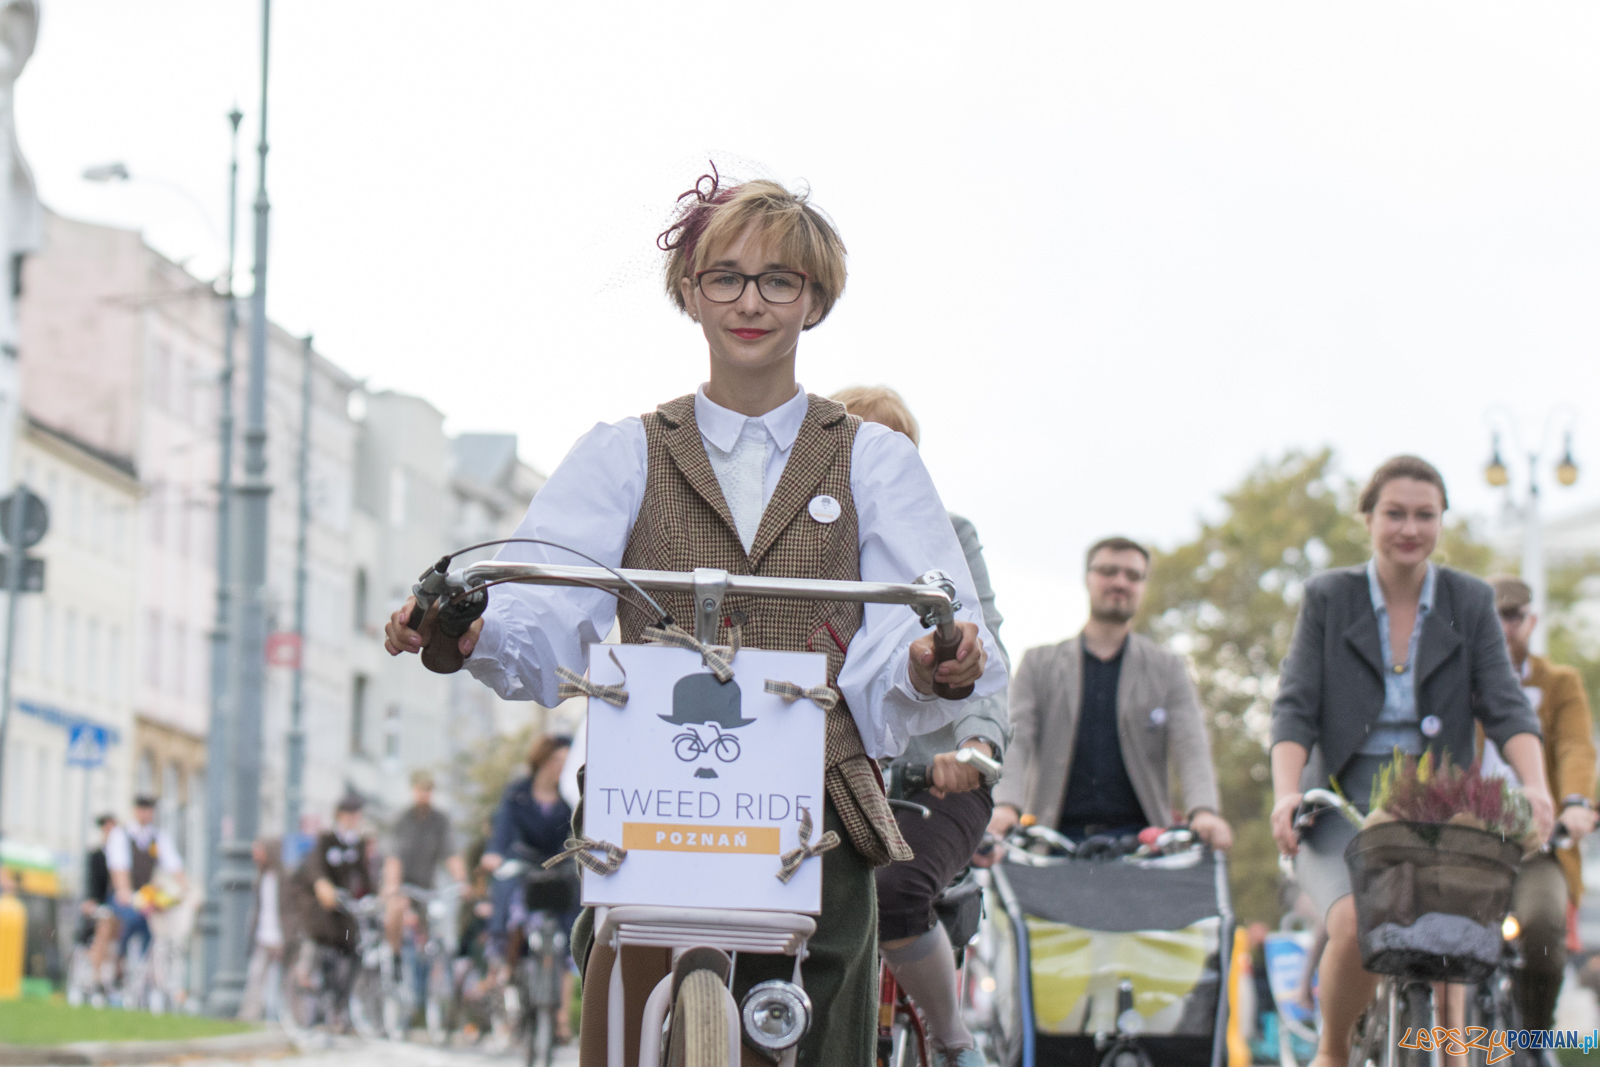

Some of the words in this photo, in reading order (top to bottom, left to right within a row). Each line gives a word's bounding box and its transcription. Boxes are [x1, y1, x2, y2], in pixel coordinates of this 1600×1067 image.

[599, 787, 720, 818] TWEED
[735, 793, 812, 822] RIDE
[656, 830, 748, 847] POZNAŃ
